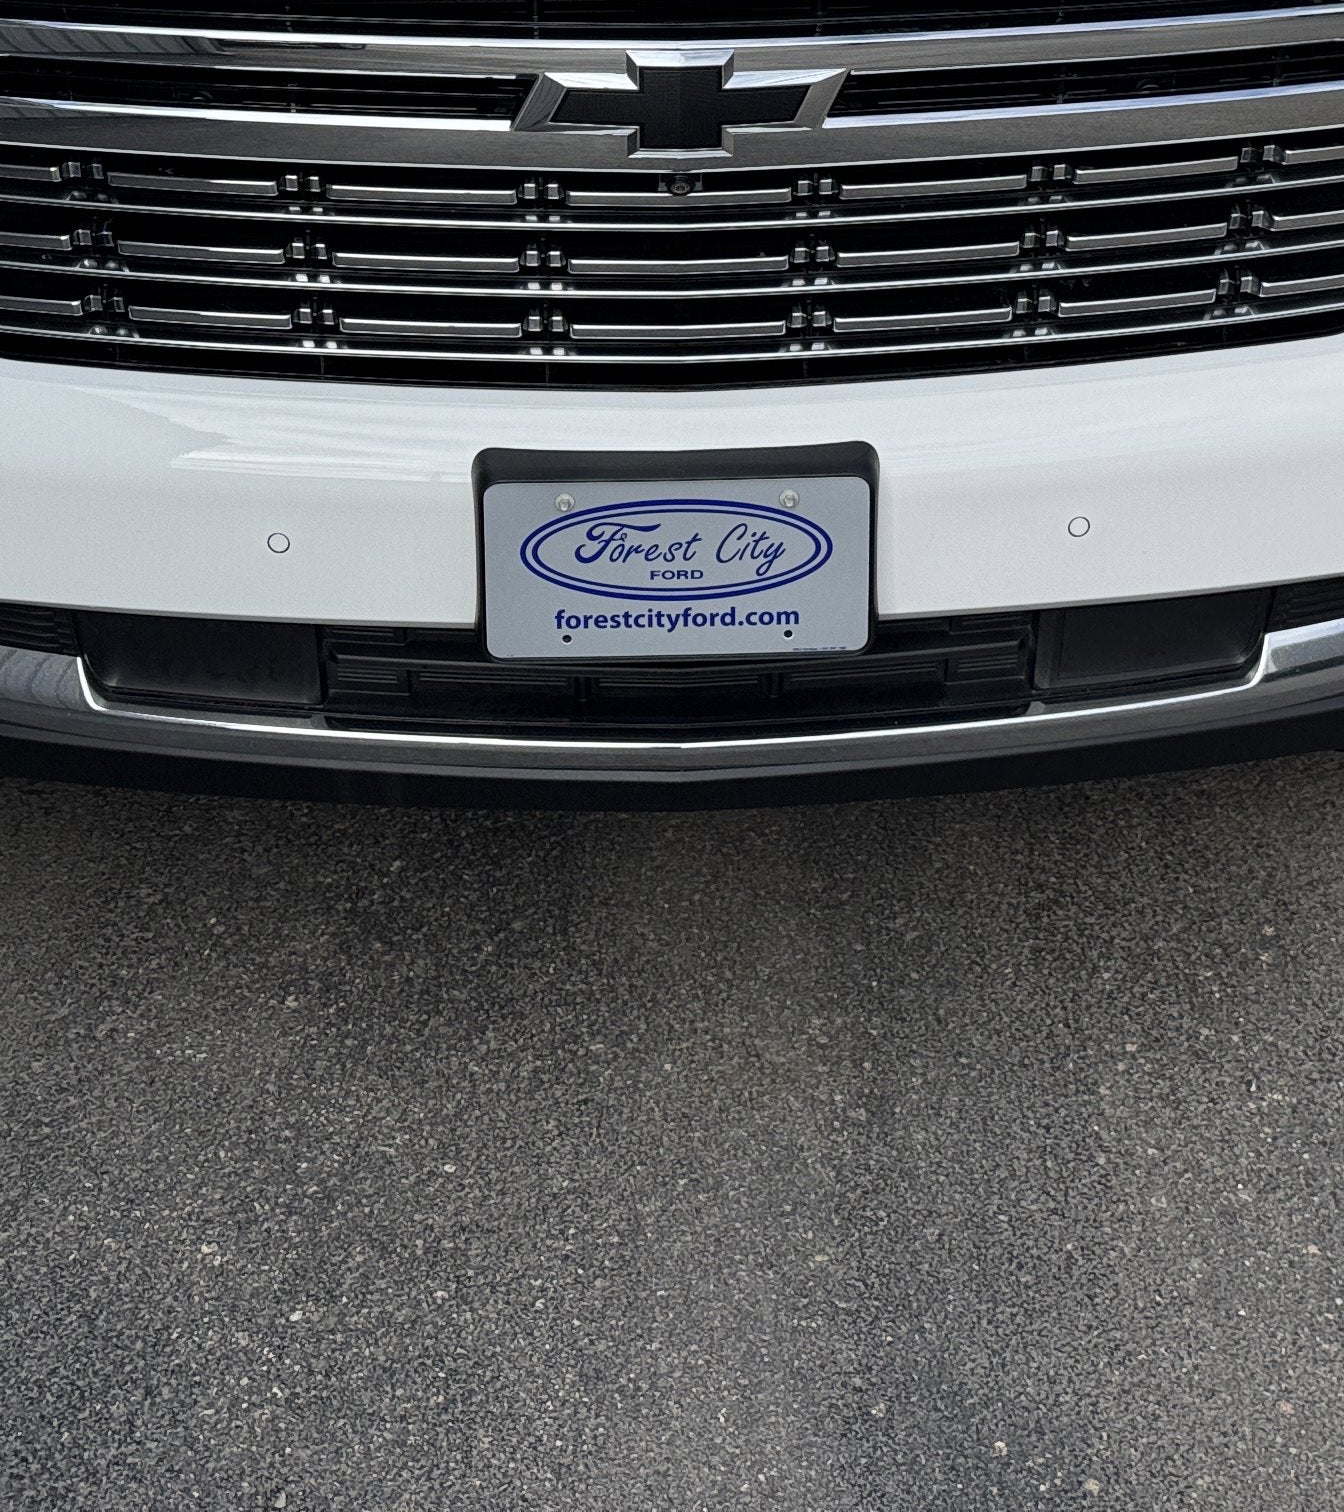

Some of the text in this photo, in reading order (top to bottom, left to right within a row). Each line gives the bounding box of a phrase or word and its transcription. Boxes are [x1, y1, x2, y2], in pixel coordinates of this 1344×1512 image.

[574, 521, 786, 577] Forest City
[649, 569, 704, 581] FORD
[554, 606, 800, 633] forestcityford.com
